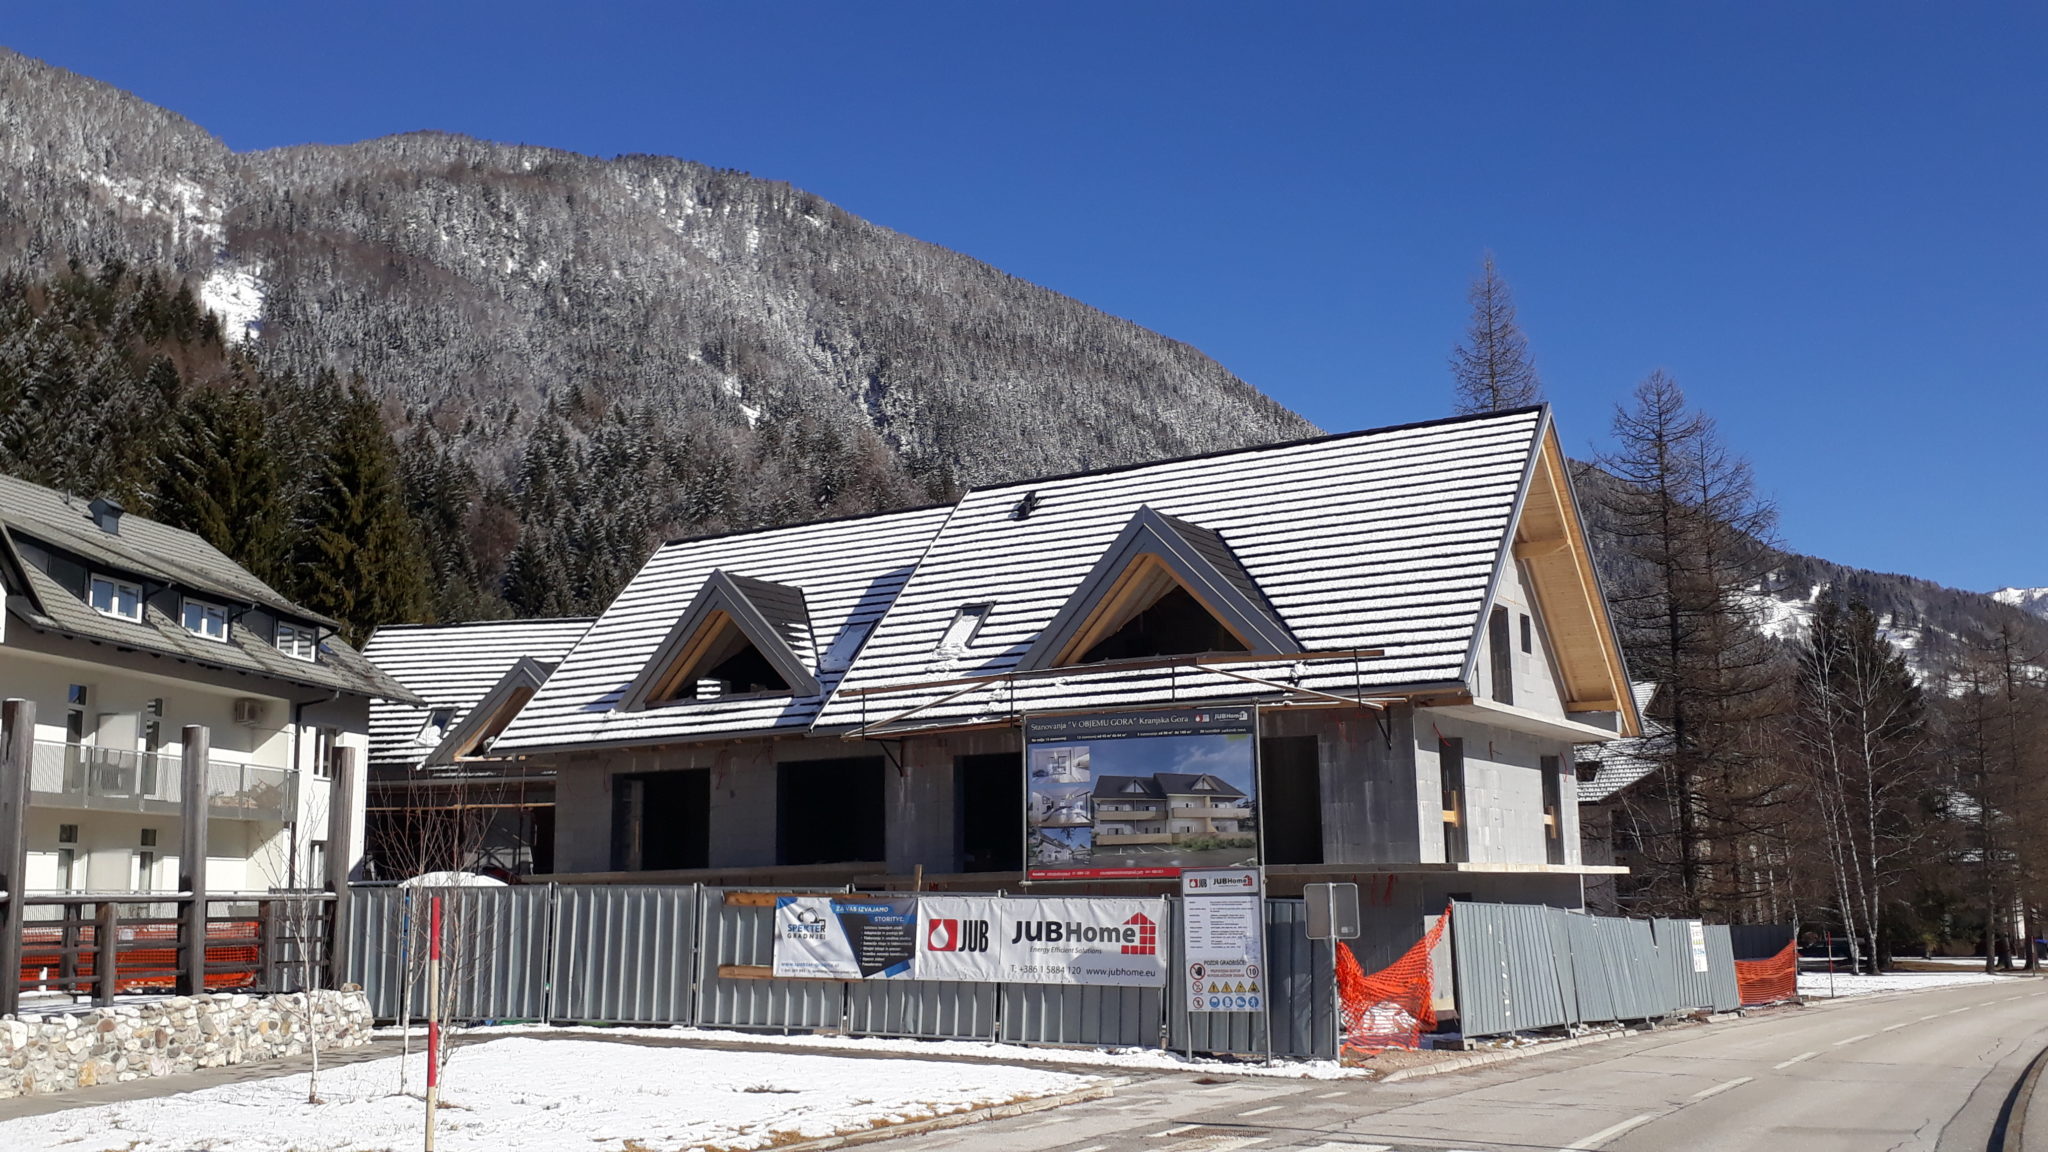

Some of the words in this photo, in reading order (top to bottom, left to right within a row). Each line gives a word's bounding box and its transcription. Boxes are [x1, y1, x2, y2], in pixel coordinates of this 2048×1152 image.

[1031, 723, 1066, 731] Stanovanja
[1078, 719, 1109, 728] OBJEMU
[1139, 717, 1170, 726] Kranjska
[1213, 877, 1247, 885] JUBHome
[787, 923, 826, 933] SPEKTER
[1011, 921, 1136, 944] JUBHome
[958, 919, 989, 952] JUB
[1030, 946, 1050, 954] Energy
[1051, 946, 1074, 954] Efficient
[1011, 964, 1017, 972] T:
[1019, 965, 1038, 974] +386
[1040, 965, 1044, 973] 1
[1046, 966, 1065, 974] 5884
[1067, 966, 1081, 975] 120
[1086, 967, 1156, 977] www.jubhome.eu
[1249, 968, 1257, 976] 10
